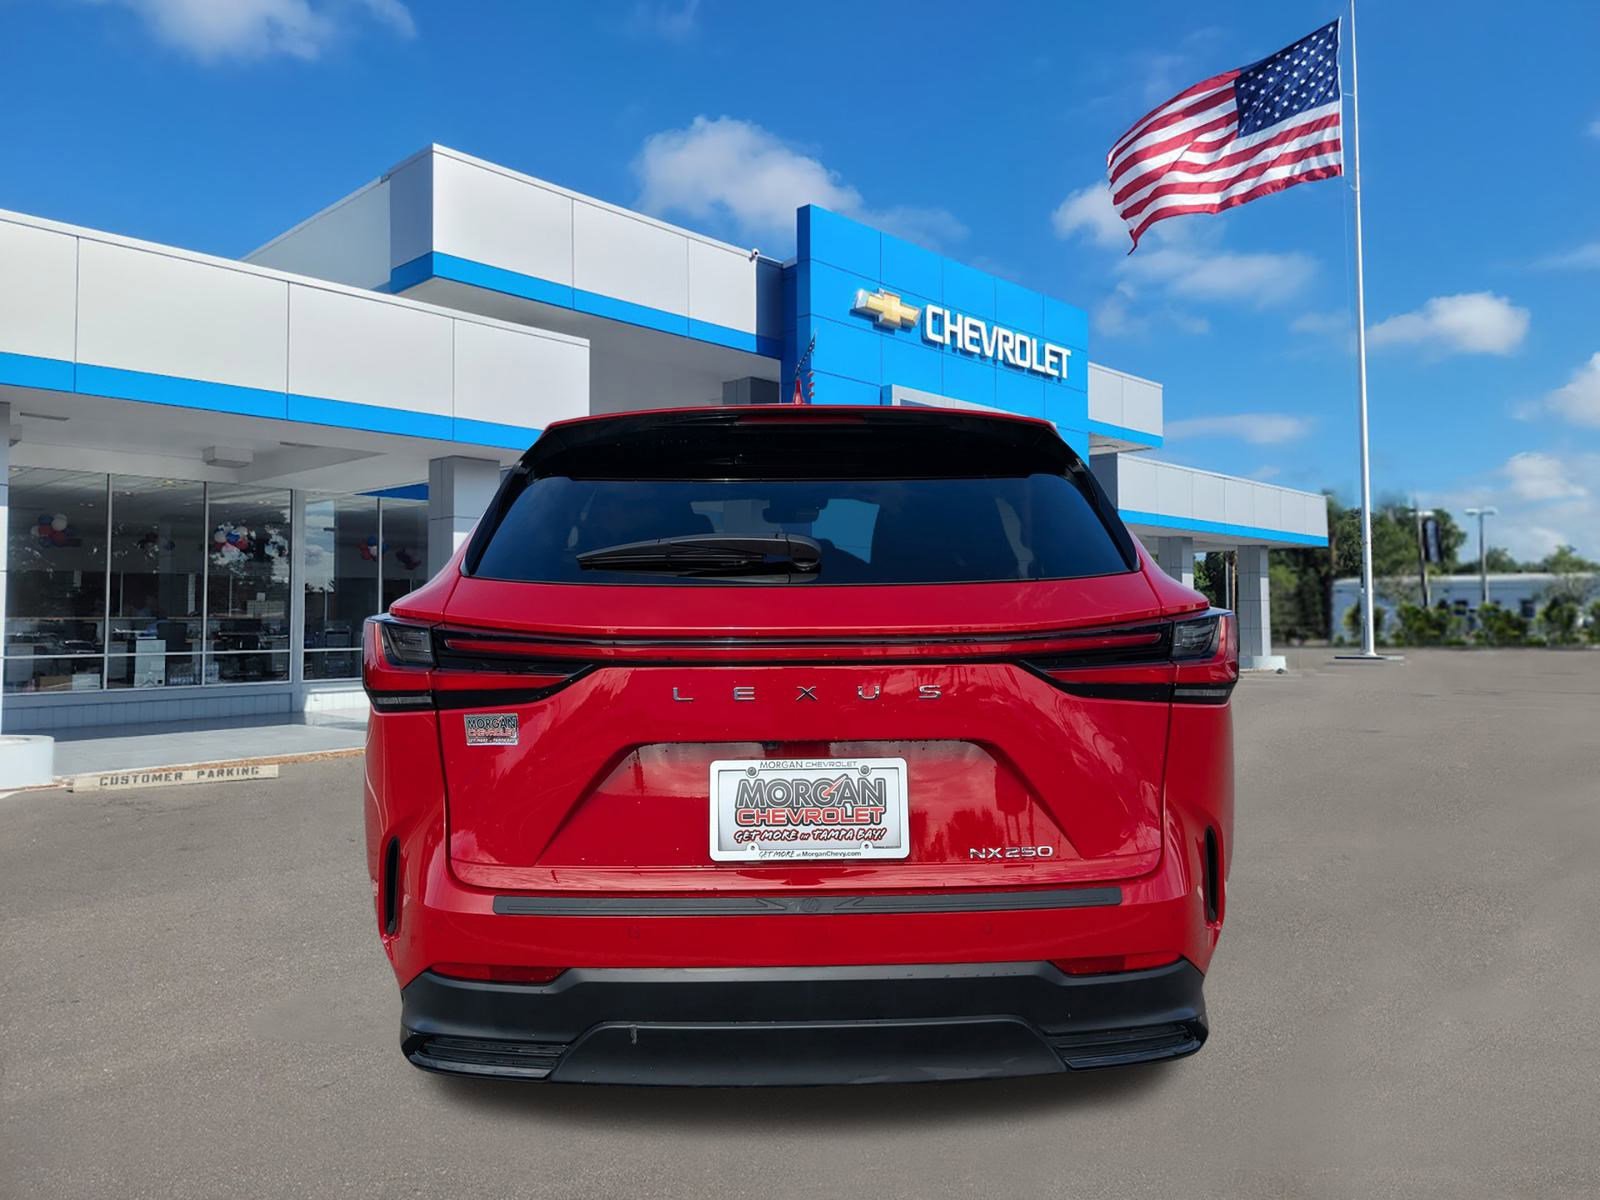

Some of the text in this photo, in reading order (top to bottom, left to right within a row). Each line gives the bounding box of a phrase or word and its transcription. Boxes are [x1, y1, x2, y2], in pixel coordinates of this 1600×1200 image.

[925, 304, 1072, 379] CHEVROLET
[672, 685, 942, 701] LEXUS
[468, 717, 516, 728] MORGAN
[760, 761, 803, 769] MORGAN
[100, 766, 259, 786] CUSTOMER PARKING
[736, 776, 886, 807] MORGAN
[736, 807, 886, 826] CHEVROLET
[734, 830, 759, 843] GET
[760, 829, 798, 841] MORE
[812, 829, 855, 841] TAMPA
[855, 828, 887, 841] BAY!
[774, 850, 795, 858] MORE
